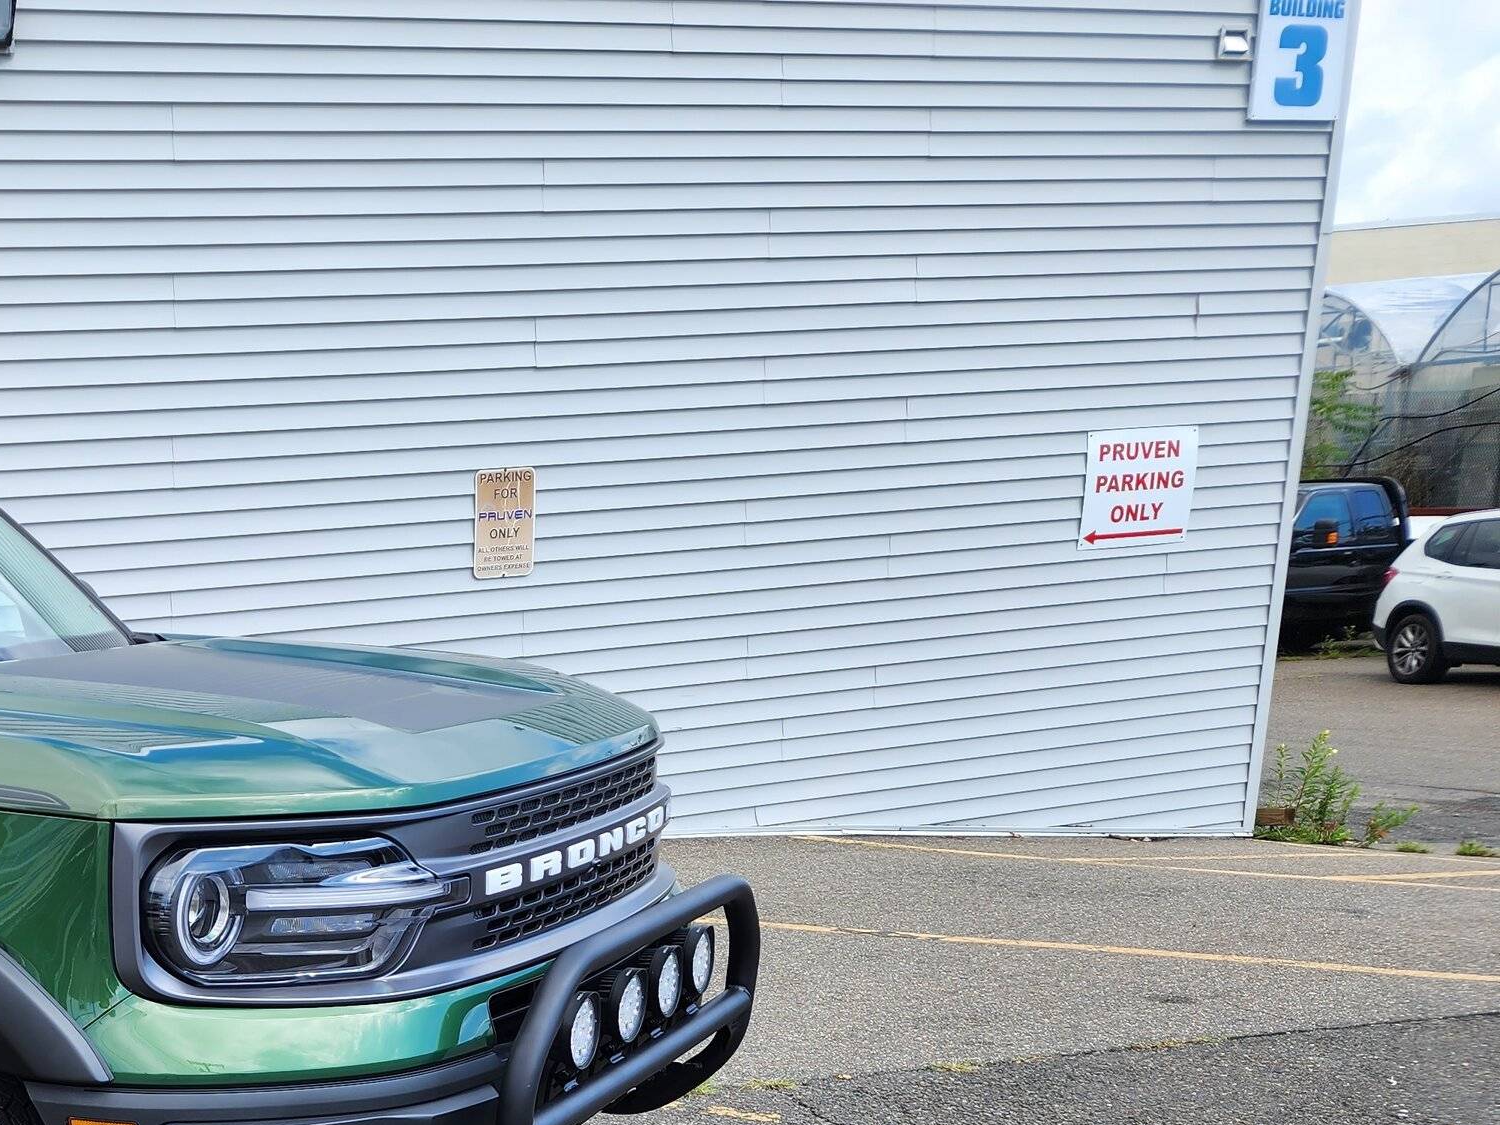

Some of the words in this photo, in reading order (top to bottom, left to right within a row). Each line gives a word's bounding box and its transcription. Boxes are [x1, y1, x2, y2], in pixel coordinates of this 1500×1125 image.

[1269, 0, 1345, 19] BUILDING
[1273, 24, 1329, 107] 3
[1099, 439, 1180, 462] PRUVEN
[480, 470, 532, 484] PARKING
[1095, 470, 1184, 493] PARKING
[494, 488, 518, 499] FOR
[478, 509, 533, 521] PRUVEN
[1110, 502, 1164, 523] ONLY
[489, 527, 520, 539] ONLY
[485, 805, 666, 896] BRONCO
